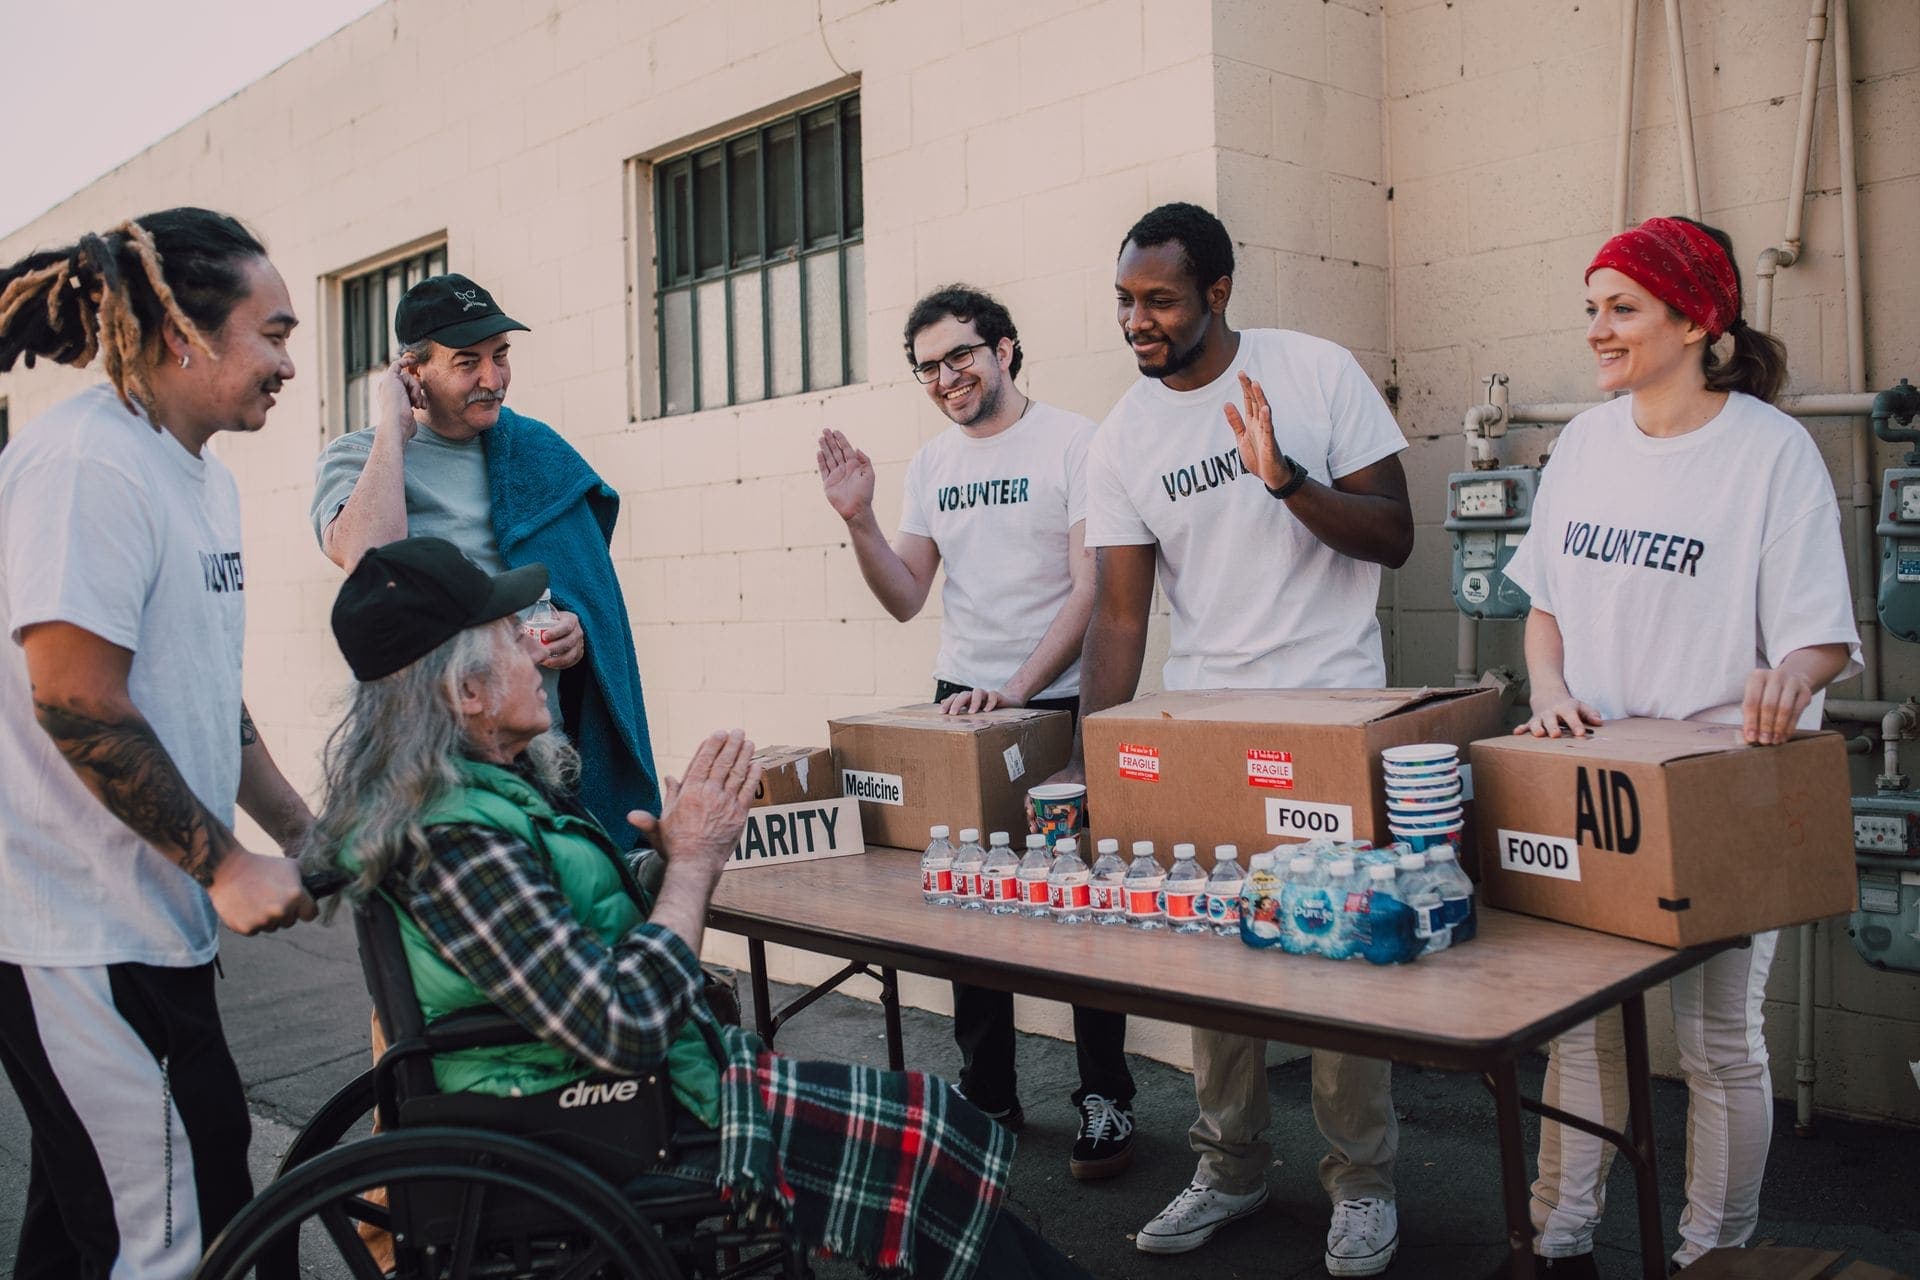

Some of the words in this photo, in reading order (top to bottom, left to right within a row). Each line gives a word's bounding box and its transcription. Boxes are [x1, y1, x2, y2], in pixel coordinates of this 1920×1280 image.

[938, 478, 1029, 512] VOLUNTEER
[1563, 521, 1705, 577] VOLUNTEER
[1122, 756, 1157, 770] FRAGILE
[1251, 763, 1290, 777] FRAGILE
[845, 773, 899, 802] Medicine
[1279, 808, 1339, 833] FOOD
[1576, 766, 1641, 855] AID
[1508, 838, 1569, 870] FOOD
[558, 1080, 639, 1109] drive
